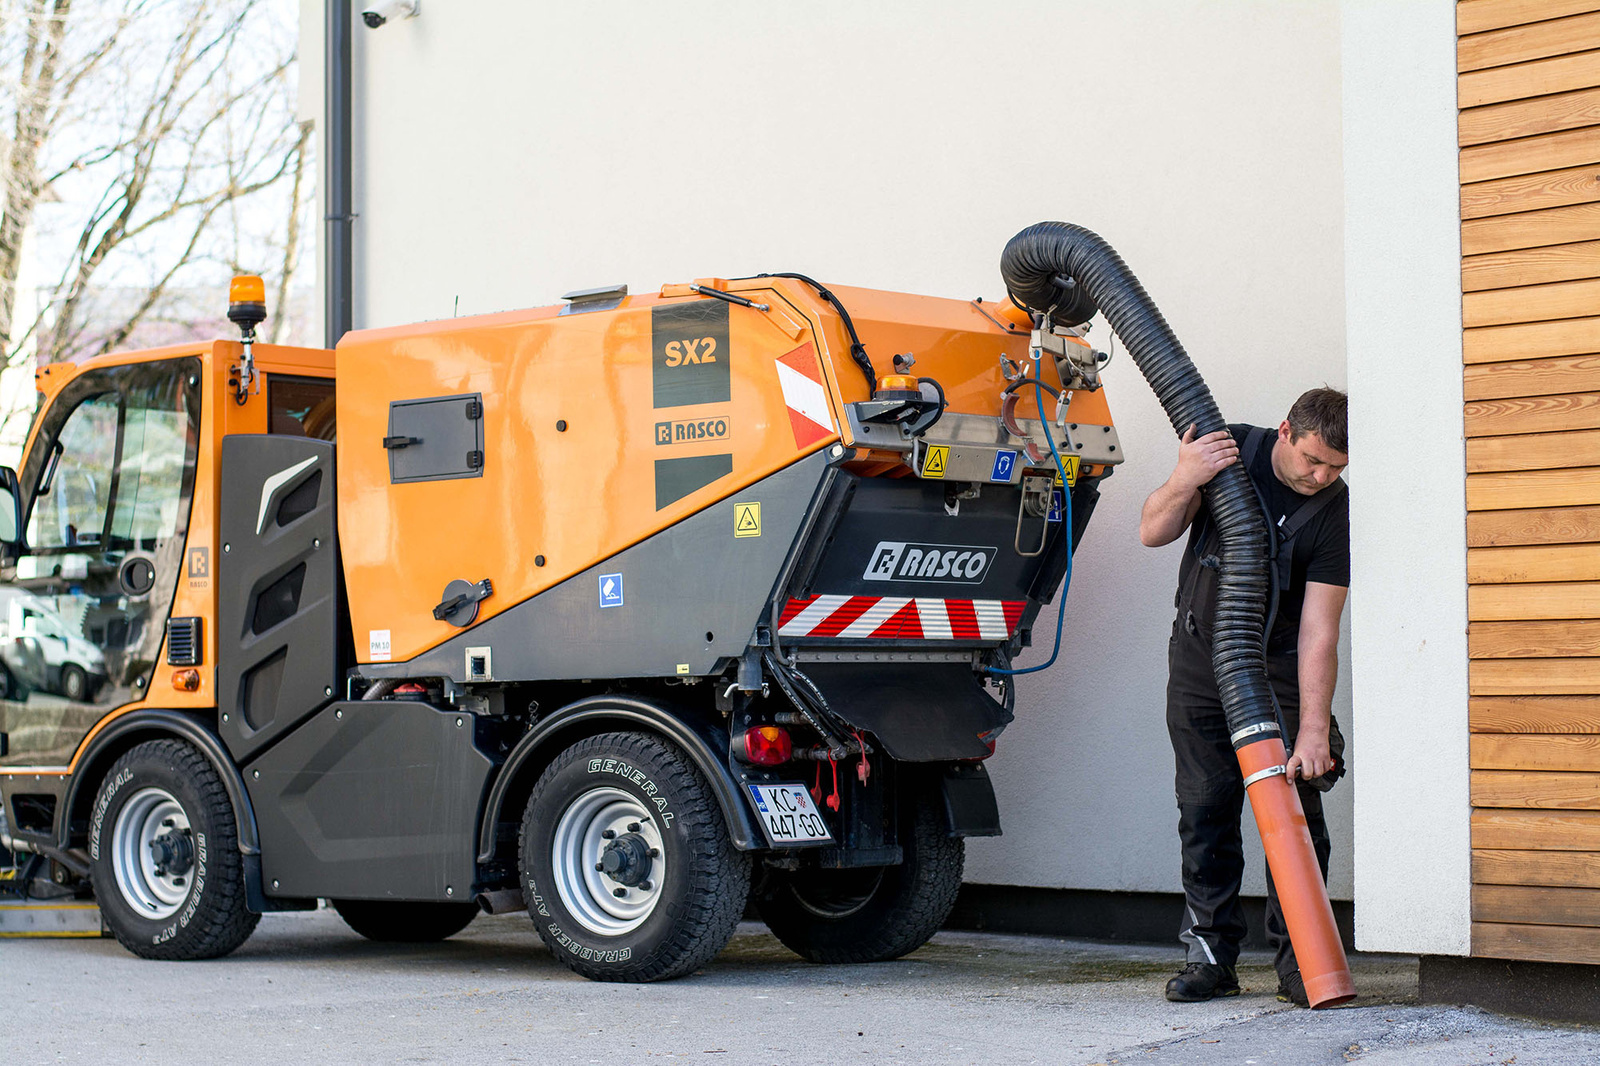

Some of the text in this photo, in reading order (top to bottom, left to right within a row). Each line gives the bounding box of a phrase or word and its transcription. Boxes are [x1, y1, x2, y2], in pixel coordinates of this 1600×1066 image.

[665, 337, 717, 367] SX2
[675, 420, 727, 440] RASCO
[899, 549, 987, 579] RASCO
[371, 641, 390, 650] PM 10
[587, 759, 674, 829] GENERAL
[768, 788, 797, 812] KC
[91, 768, 134, 861] GENERAL
[180, 832, 207, 928] GRABBER
[548, 923, 632, 963] GRABBER
